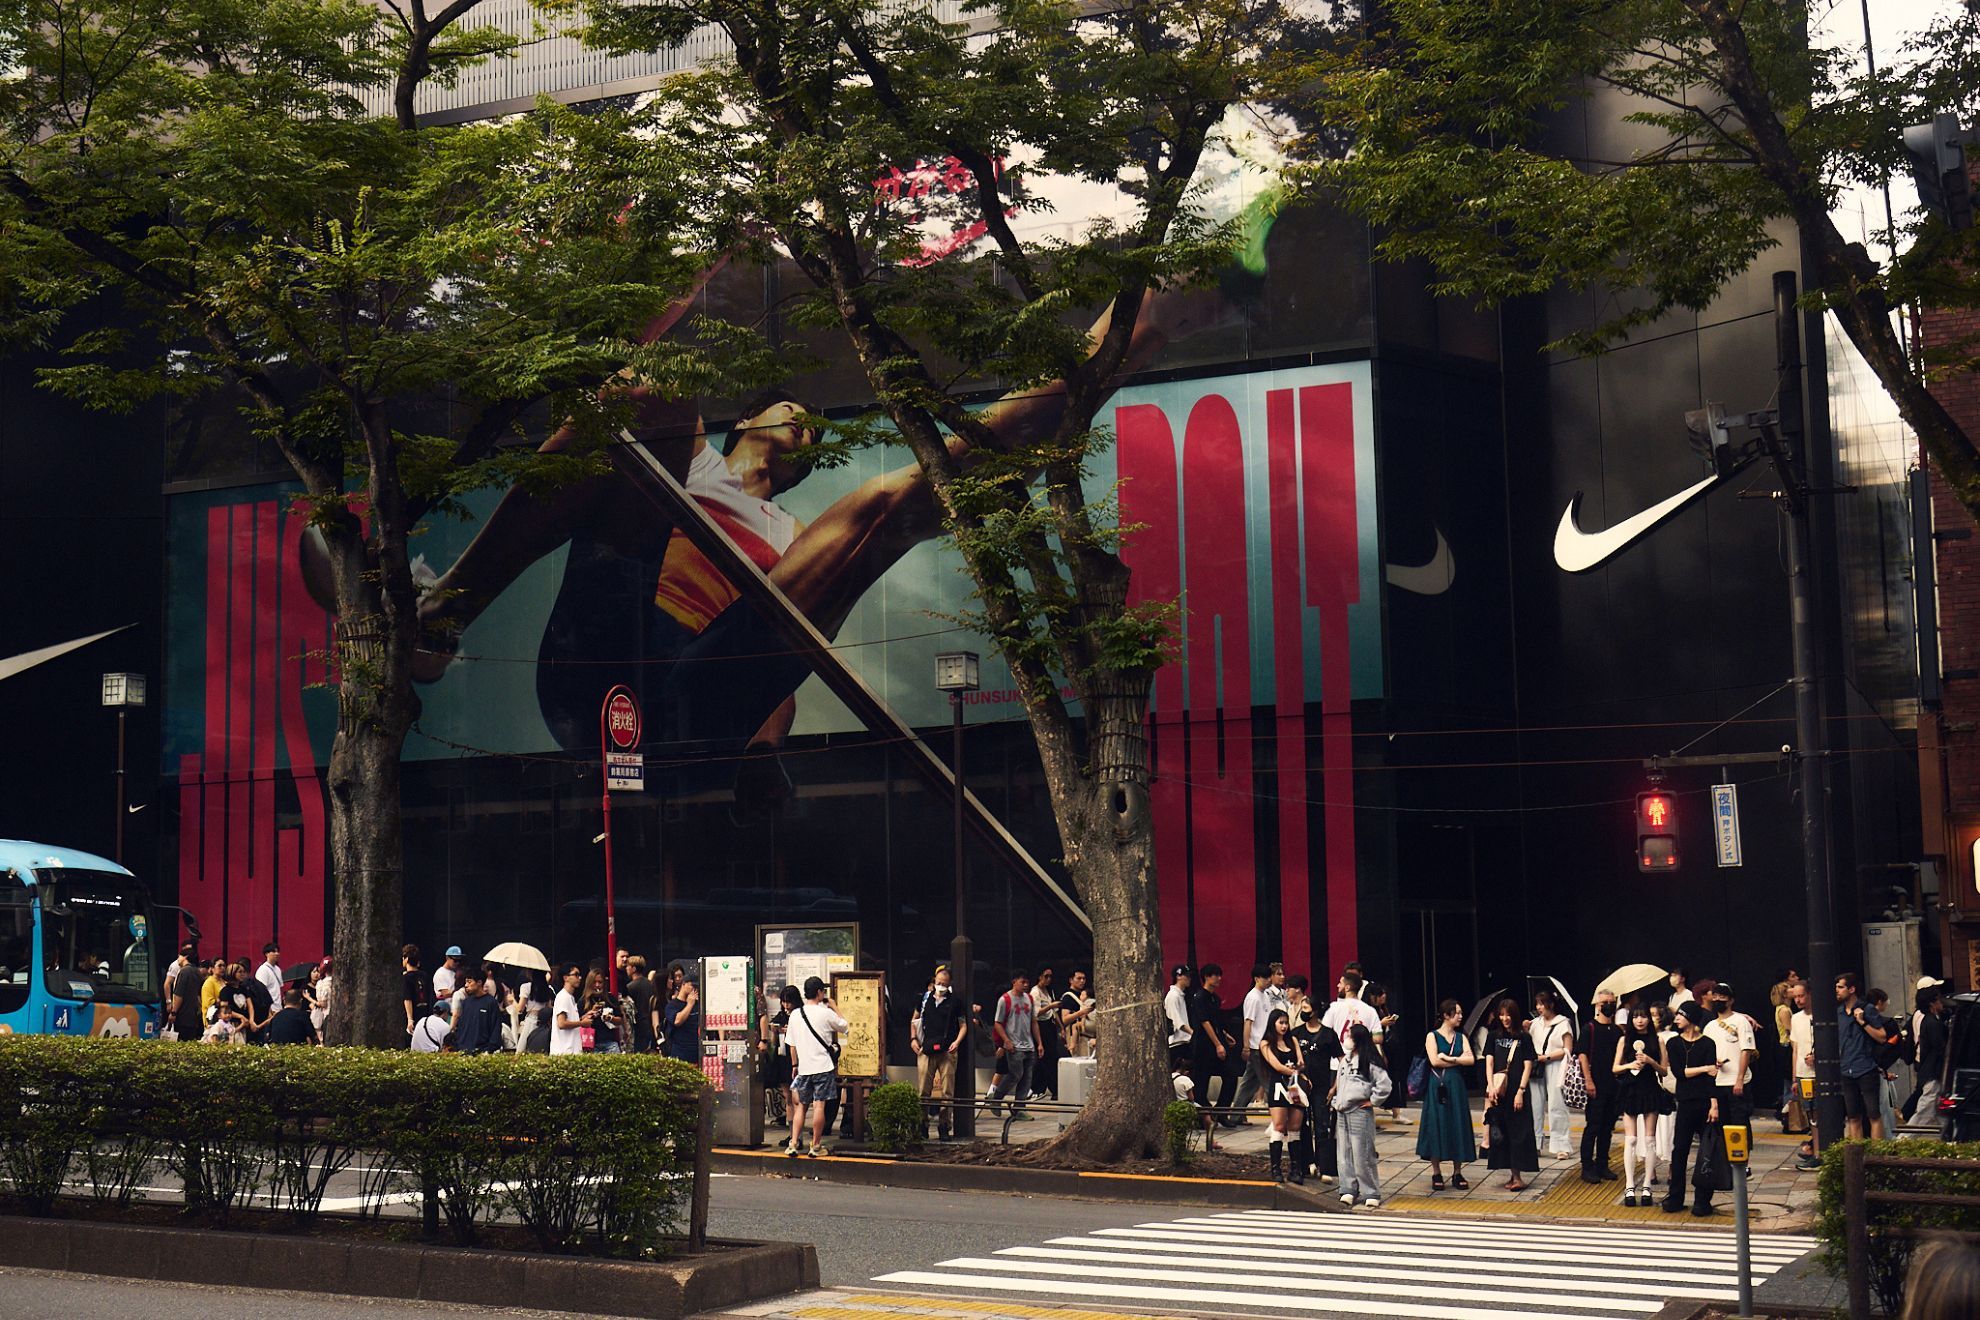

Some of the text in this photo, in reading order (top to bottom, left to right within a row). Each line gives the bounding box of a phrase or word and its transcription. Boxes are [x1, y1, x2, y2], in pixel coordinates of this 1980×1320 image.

[179, 491, 371, 985] JUS
[612, 711, 634, 731] 消火栓
[948, 690, 1022, 706] SHUNSUK
[1265, 381, 1361, 1000] IT
